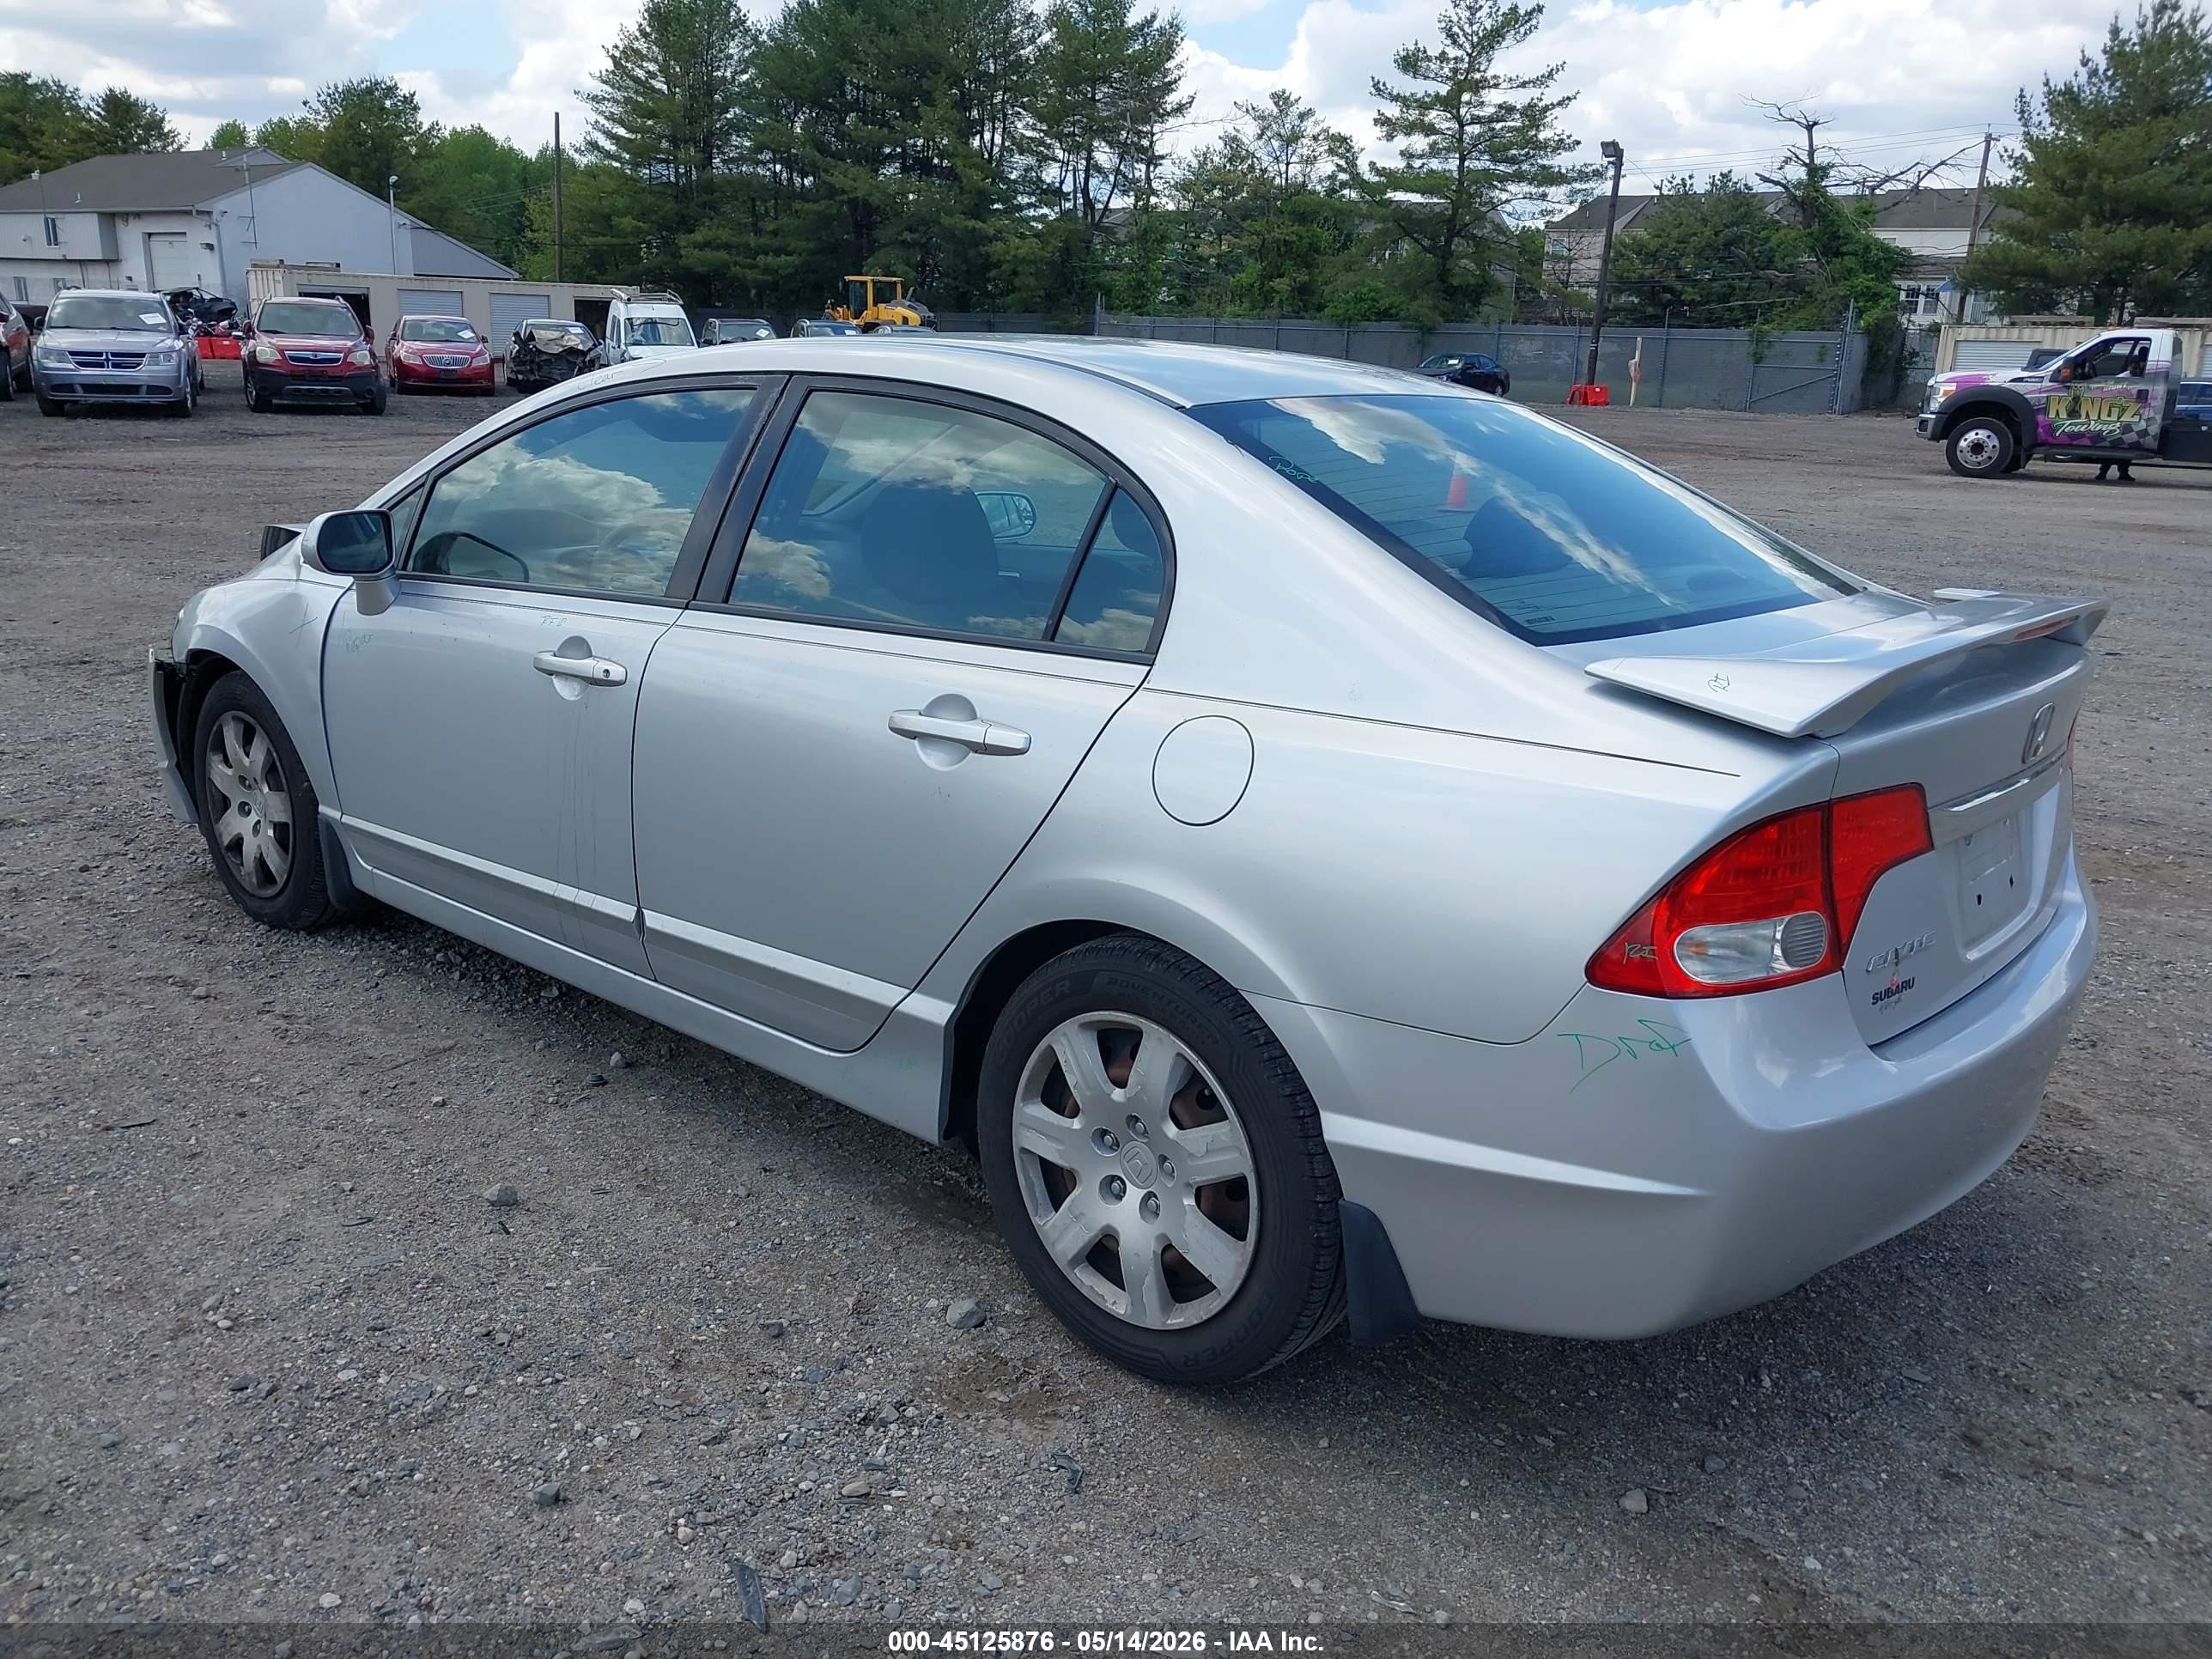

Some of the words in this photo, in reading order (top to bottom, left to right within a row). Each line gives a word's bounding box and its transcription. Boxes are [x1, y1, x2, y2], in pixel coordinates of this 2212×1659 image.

[2054, 418, 2121, 436] Towing
[1866, 929, 1937, 973] CIVIC
[1871, 976, 1916, 1006] SUBARU
